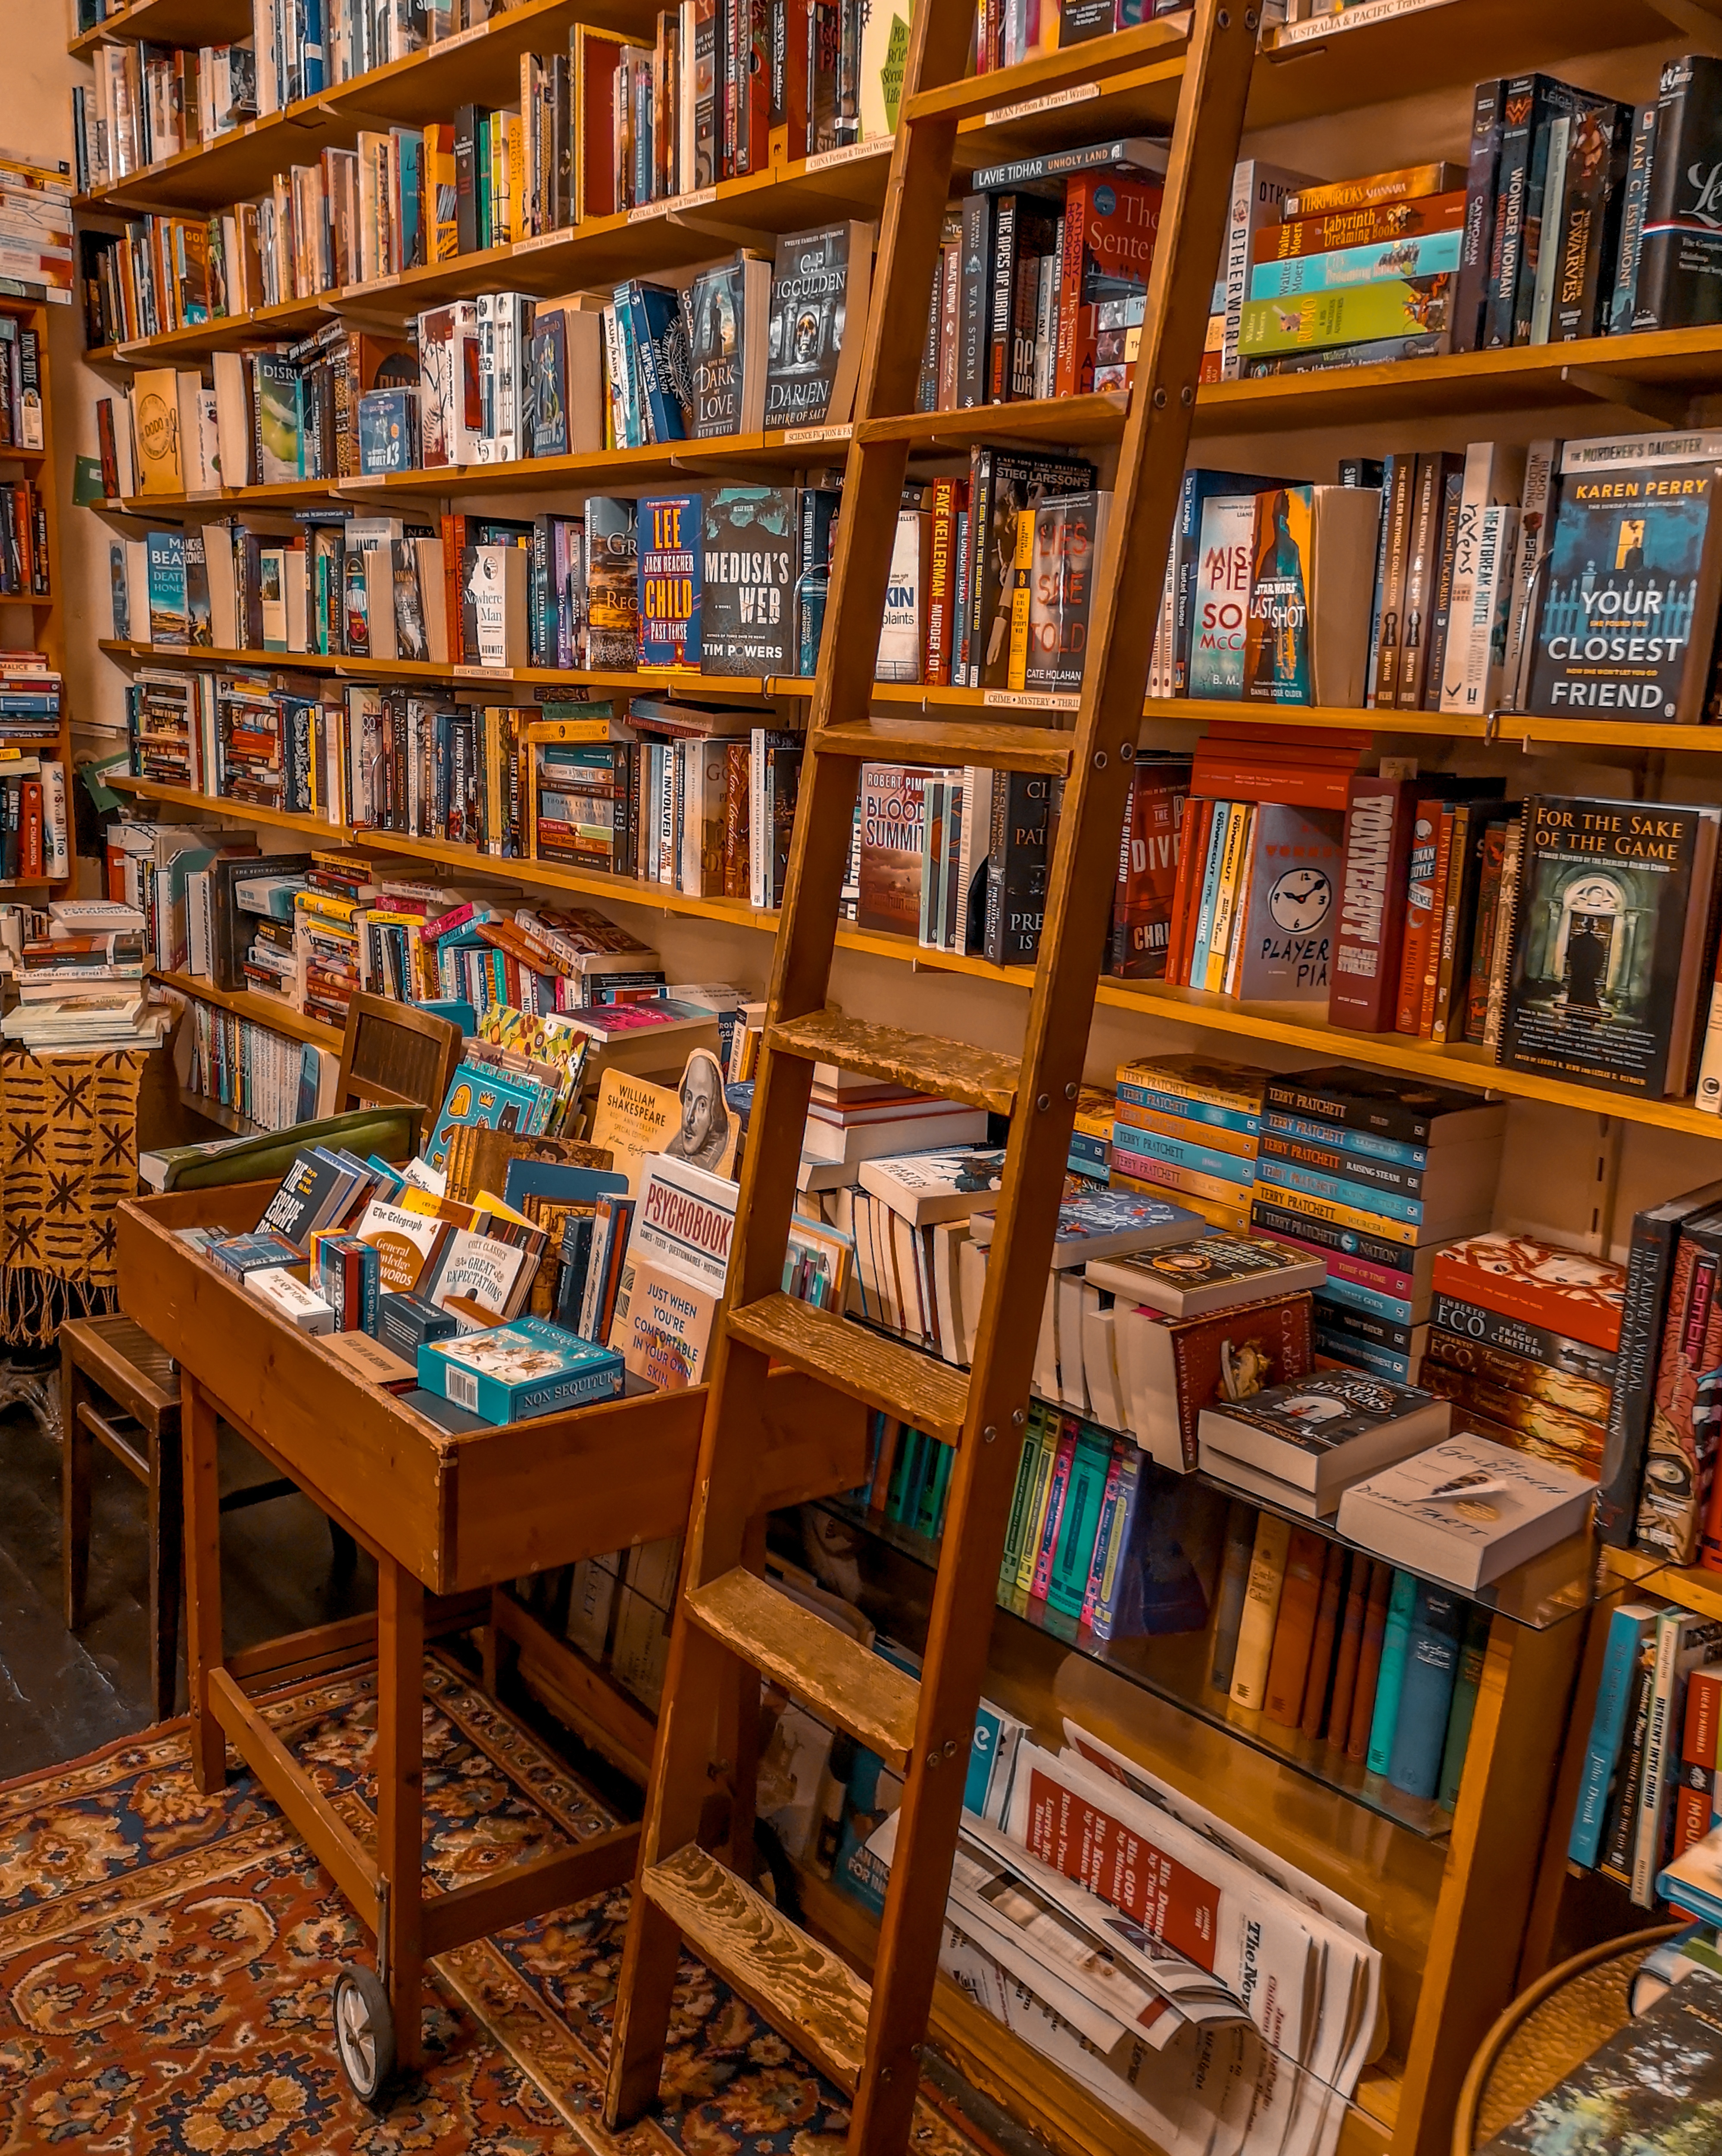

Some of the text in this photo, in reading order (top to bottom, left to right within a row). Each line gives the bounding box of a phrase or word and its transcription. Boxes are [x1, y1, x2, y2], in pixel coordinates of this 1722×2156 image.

[1288, 3, 1394, 40] AUSTRALIA & PACIFIC
[991, 108, 1017, 120] JAPAN
[1045, 91, 1067, 106] Travel
[811, 156, 828, 168] CHINA
[854, 143, 872, 156] Travel
[979, 150, 1107, 185] LAVIE TIDHAR UNHOLY LAND
[1301, 185, 1363, 212] TERRY BROOKS
[1619, 135, 1646, 289] IAN ESSLEMONT
[1323, 208, 1376, 236] Labyrinth
[1469, 196, 1483, 267] CATWOMAN
[1499, 167, 1523, 299] WONDER WOMAN
[1064, 203, 1074, 279] HOROWITZ
[1073, 202, 1082, 275] ANTHONY
[1324, 227, 1369, 247] Dreaming
[777, 271, 846, 299] IGGULDEN
[993, 208, 1014, 333] THE APES OF WRATH
[1225, 228, 1246, 368] OTHERWORLD
[966, 285, 977, 380] WAR STORM
[1298, 299, 1316, 343] RUMO
[699, 364, 734, 393] DARK
[699, 395, 733, 421] LOVE
[770, 380, 829, 409] DARIEN
[698, 424, 733, 437] BETH REVIS
[766, 408, 827, 426] EMPIRE OF SALT
[789, 432, 812, 441] SCIENCE
[996, 467, 1090, 487] STIEG LARSSON'S
[1576, 480, 1708, 498] KAREN PERRY
[654, 508, 681, 549] LEE
[1039, 524, 1087, 557] LIES
[645, 555, 694, 572] JACK REACHER
[705, 552, 789, 584] MEDUSA'S
[928, 485, 950, 671] FAYE KELLERMAN MURDER 101
[1472, 511, 1499, 626] HEARTBREAK HOTEL
[465, 592, 502, 604] Nowhere
[646, 579, 692, 619] CHILD
[1038, 574, 1083, 604] SHE
[1255, 583, 1297, 595] STAR WARS
[1582, 592, 1663, 614] YOUR
[481, 607, 502, 621] Man
[739, 587, 780, 624] WEB
[1251, 598, 1305, 629] LAST SHOT
[651, 622, 688, 641] PAST TENSE
[1030, 623, 1085, 652] TOLD
[481, 645, 503, 654] HURWITZ
[703, 644, 723, 656] TIM
[1548, 638, 1682, 662] CLOSEST
[1027, 669, 1081, 681] CATE HOLAHAN
[1383, 651, 1392, 682] NEVINS
[1405, 651, 1414, 682] NEVINS
[989, 695, 1050, 706] CRIME MYSTERY
[1251, 689, 1270, 697] DANIEL
[1285, 690, 1302, 698] OLDER
[1551, 682, 1663, 708] FRIEND
[662, 750, 673, 838] ALL INVOLVED
[867, 773, 902, 788] ROBERT
[867, 796, 925, 821] BLOOD
[1536, 808, 1684, 839] FOR THE SAKE
[1118, 826, 1131, 883] DIVERSION
[1535, 831, 1678, 861] OF THE GAME
[1341, 795, 1394, 944] VONNEGUT
[1318, 895, 1326, 905] 3
[1294, 919, 1300, 928] 6
[1443, 906, 1455, 960] SHERLOCK
[1261, 938, 1329, 964] PLAYER
[619, 1084, 656, 1108] WILLIAM
[1270, 1087, 1347, 1118] TERRY PRATCHETT
[607, 1095, 666, 1127] SHAKESPEARE
[1120, 1131, 1185, 1159] TERRY PRATCHETT
[1263, 1137, 1340, 1169] TERRY PRATCHETT
[282, 1159, 309, 1194] THE
[265, 1190, 305, 1234] ESCAPE
[1260, 1187, 1336, 1219] TERRY PRATCHETT
[387, 1211, 423, 1232] Telegraph
[429, 1221, 437, 1234] 4
[645, 1183, 733, 1257] PSYCHOBOOK
[376, 1238, 410, 1257] General
[468, 1240, 508, 1260] COZY CLASSICS
[1359, 1243, 1398, 1263] NATION
[467, 1256, 495, 1273] GREAT
[1338, 1263, 1386, 1284] THIEF OF TIME
[446, 1270, 502, 1302] EXPECTATIONS
[647, 1283, 697, 1319] JUST WHEN
[654, 1305, 684, 1334] YOU'RE
[1436, 1303, 1486, 1337] ECO
[634, 1317, 699, 1363] COMFORTABLE
[1491, 1333, 1544, 1357] CEMETERY
[1499, 1326, 1538, 1346] PRAGUE
[633, 1335, 692, 1380] IN YOUR OWN
[524, 1371, 614, 1408] NON SEQUITUR
[1182, 1396, 1194, 1462] DAVIDSON
[1413, 1507, 1489, 1536] TARTT
[1582, 1752, 1606, 1824] John Dvorak
[1060, 1792, 1071, 1835] Robert
[1124, 1838, 1139, 1908] His GOP
